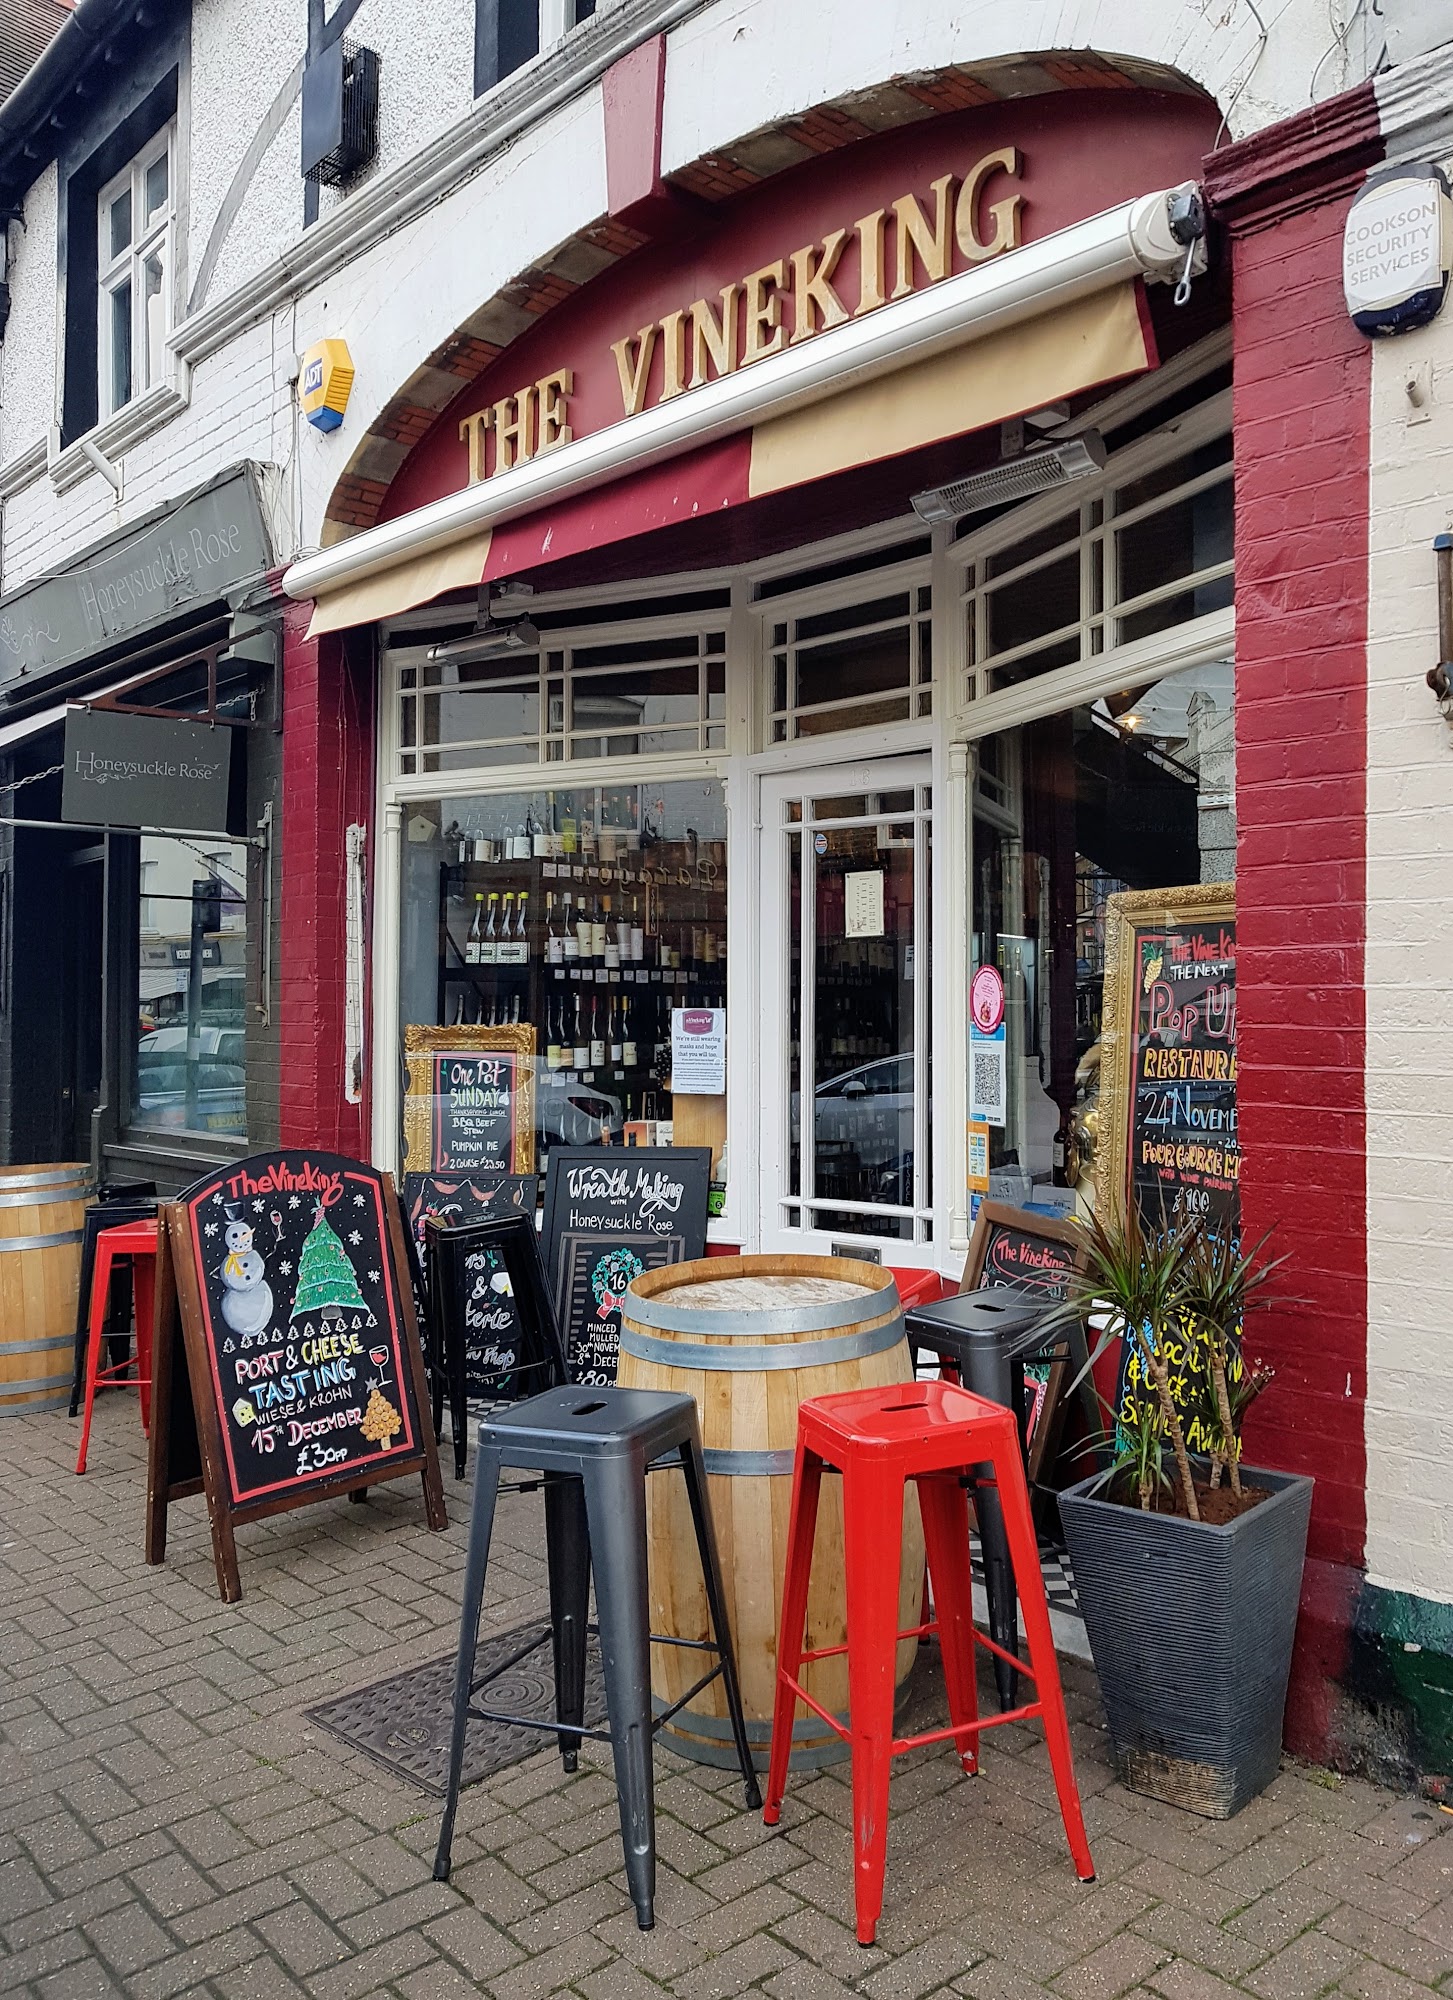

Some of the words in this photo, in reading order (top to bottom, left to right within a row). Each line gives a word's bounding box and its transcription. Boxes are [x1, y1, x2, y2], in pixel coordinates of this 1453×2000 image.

[1345, 201, 1437, 246] COOKSON
[1346, 223, 1434, 268] SECURITY
[1350, 247, 1430, 287] SERVICES
[458, 367, 574, 487] THE
[609, 145, 1025, 417] VINEKING
[304, 363, 322, 390] ADT
[81, 540, 191, 621] Honeysuckle
[188, 524, 242, 570] Rose
[75, 750, 176, 777] Honeysuckle
[179, 763, 212, 780] Rose
[1170, 964, 1193, 981] THE
[1195, 963, 1229, 979] NEXT
[451, 1062, 475, 1086] One
[477, 1060, 506, 1087] Pot
[450, 1086, 500, 1108] SUNDAY
[452, 1117, 474, 1128] BBQ
[475, 1118, 497, 1128] BEEF
[451, 1141, 483, 1151] PUMPKIN
[487, 1140, 499, 1151] PIE
[1142, 1140, 1175, 1168] FOUR
[1176, 1144, 1222, 1177] COURSE
[450, 1158, 456, 1169] 2
[456, 1159, 479, 1168] COURSE
[228, 1168, 273, 1199] The
[567, 1165, 630, 1200] Wreath
[630, 1166, 684, 1218] Making
[569, 1208, 642, 1231] Honeysuckle
[648, 1214, 674, 1237] Rose
[996, 1239, 1018, 1262] The
[609, 1274, 626, 1291] 16
[587, 1323, 617, 1333] MINCED
[589, 1333, 619, 1342] MULLED
[235, 1352, 284, 1385] PORT
[285, 1344, 300, 1370] &
[301, 1333, 364, 1366] CHEESE
[592, 1353, 619, 1367] DECE
[593, 1341, 620, 1353] NOVEM
[248, 1357, 357, 1410] TASTING
[254, 1400, 295, 1425] WIESE
[296, 1400, 306, 1414] &
[308, 1385, 353, 1408] KROHN
[287, 1406, 363, 1448] DECEMBER
